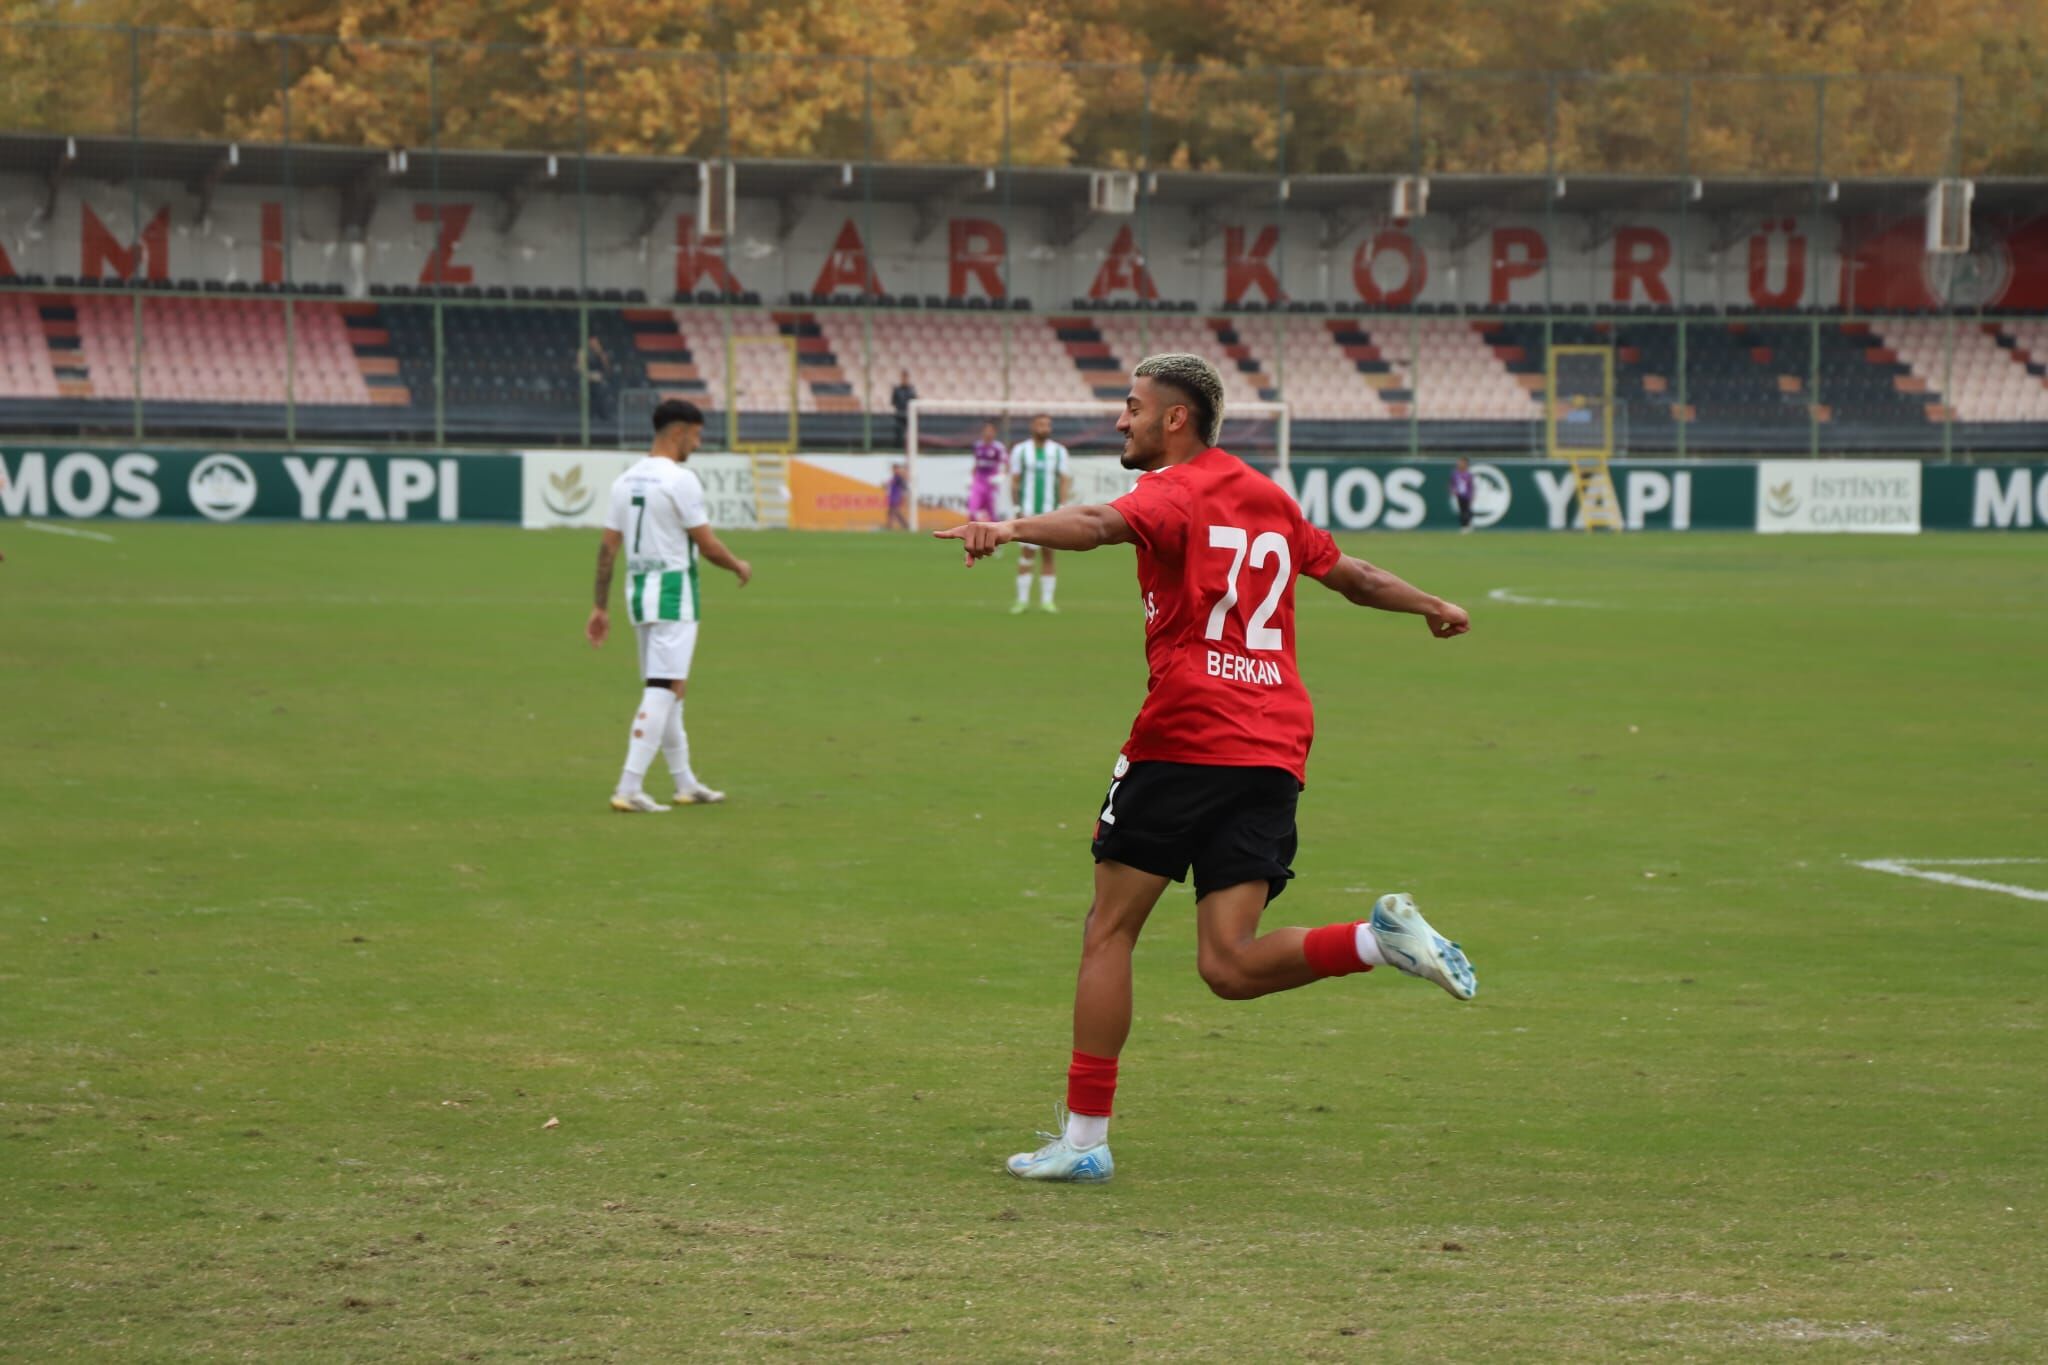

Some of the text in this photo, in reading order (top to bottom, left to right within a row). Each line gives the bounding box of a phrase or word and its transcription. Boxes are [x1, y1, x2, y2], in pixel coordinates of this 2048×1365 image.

[0, 201, 1806, 308] MIZ KARAKÖPRÜ
[0, 452, 459, 521] MOS YAPI
[1809, 504, 1912, 526] GARDEN
[631, 496, 645, 554] 7
[1205, 525, 1291, 650] 72
[1207, 650, 1283, 686] BERKAN
